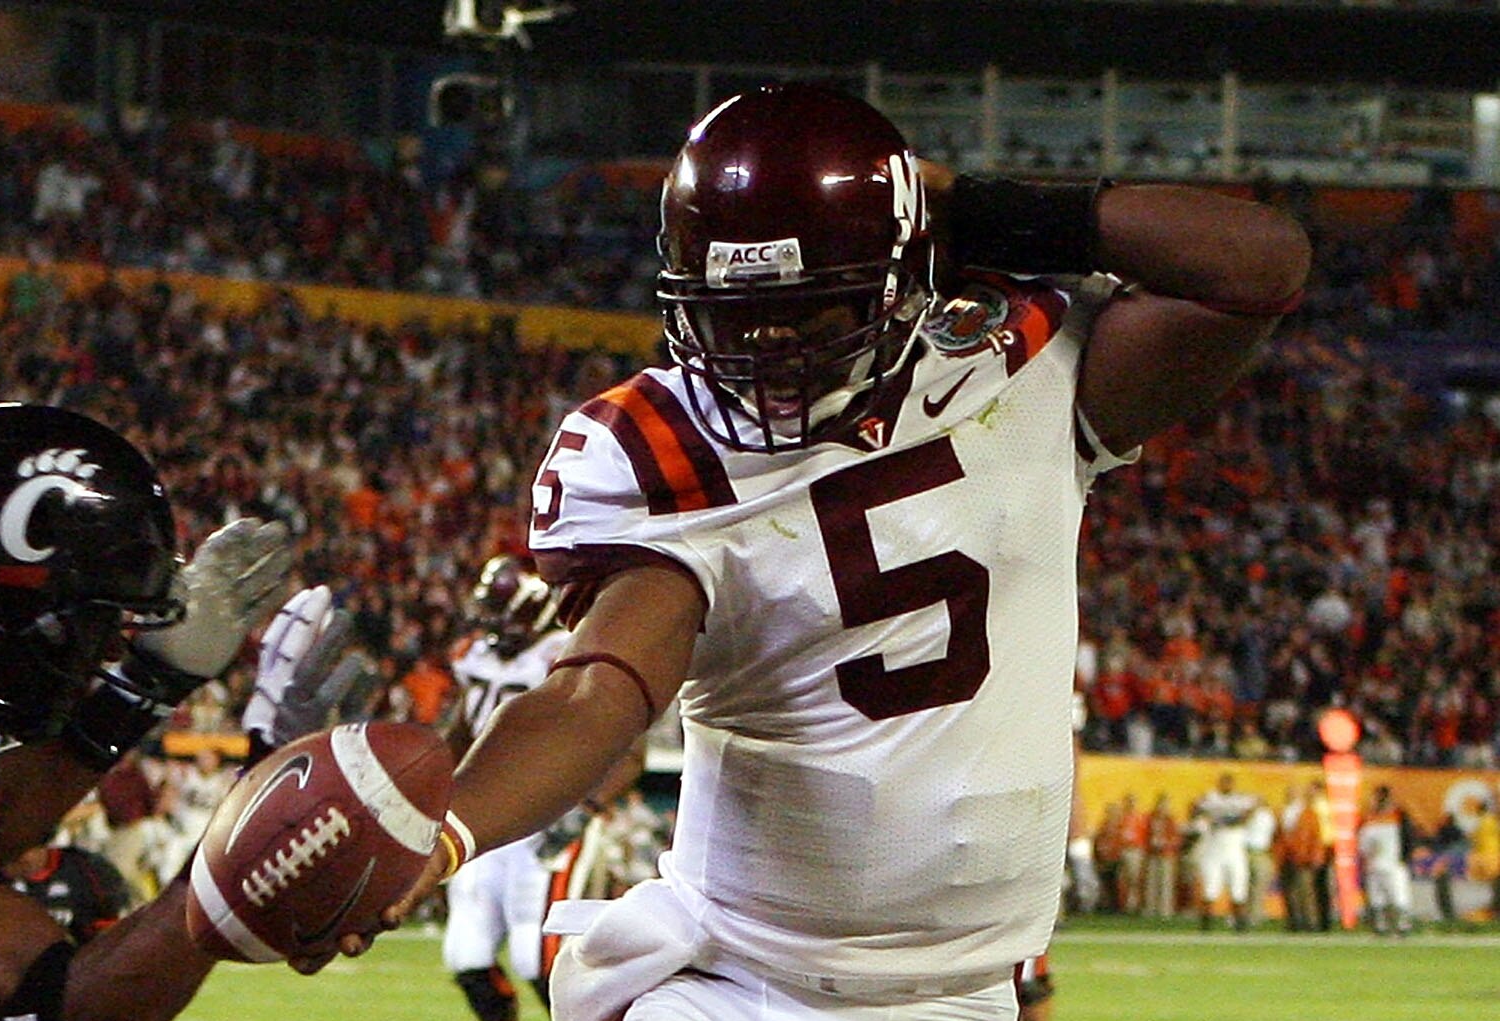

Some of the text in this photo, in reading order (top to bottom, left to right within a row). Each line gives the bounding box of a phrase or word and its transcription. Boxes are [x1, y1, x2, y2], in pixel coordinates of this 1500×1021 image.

[729, 245, 773, 265] ACC
[534, 430, 588, 531] 5
[809, 434, 991, 722] 5
